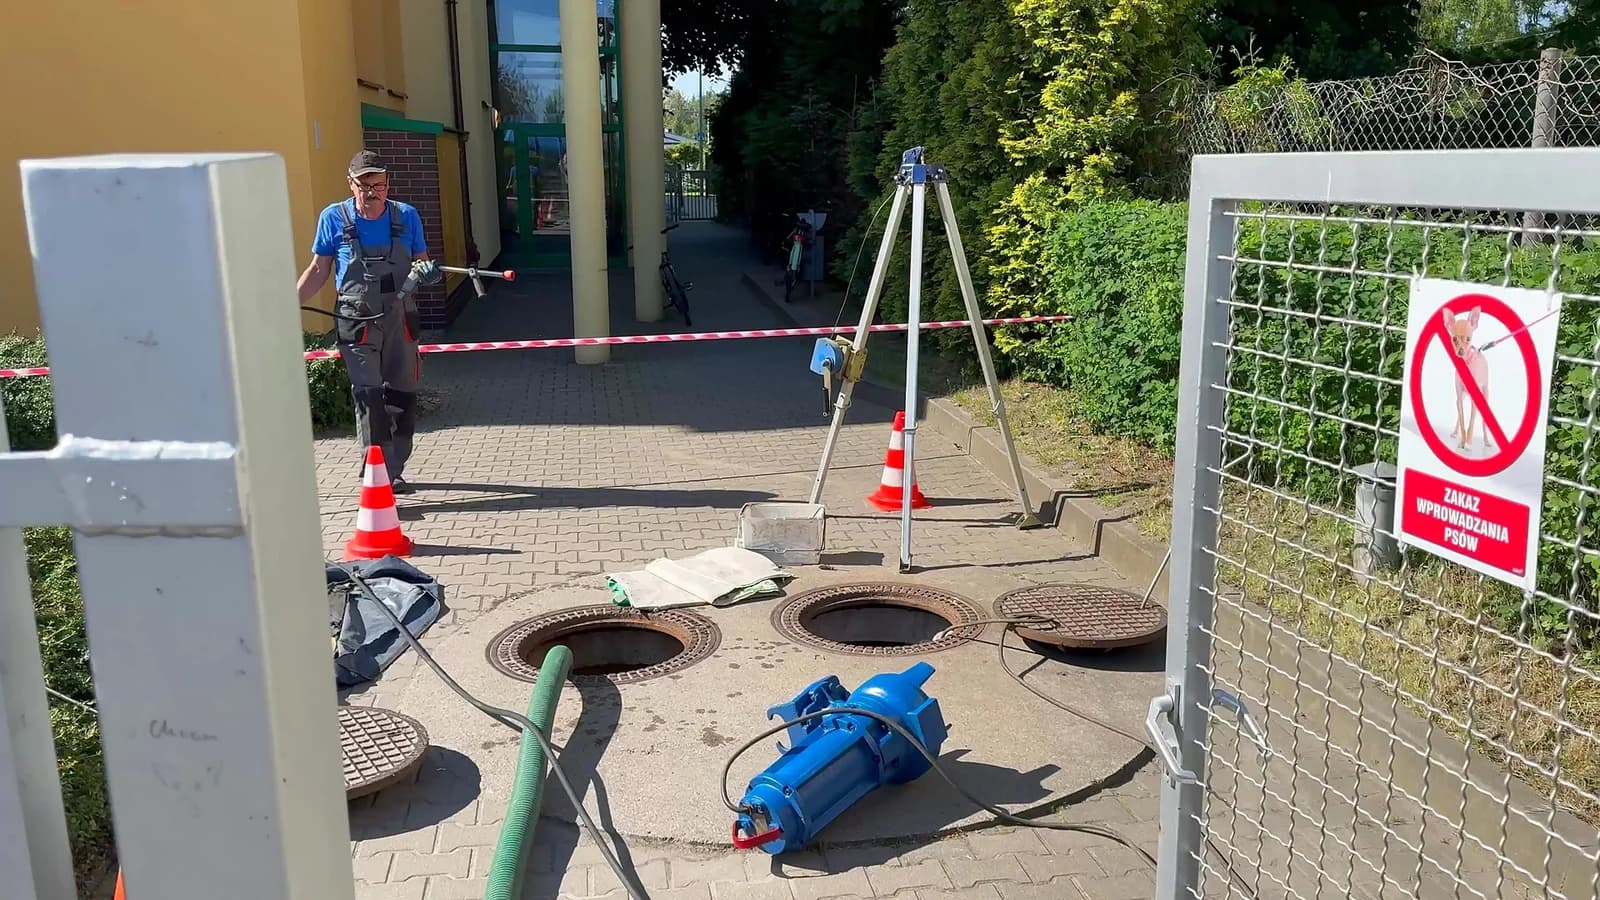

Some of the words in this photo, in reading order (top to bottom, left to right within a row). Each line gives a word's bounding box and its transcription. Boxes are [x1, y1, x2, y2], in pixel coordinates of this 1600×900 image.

[1443, 487, 1480, 512] ZAKAZ
[1416, 497, 1509, 543] WPROWADZANIA
[1444, 527, 1479, 552] PSÓW
